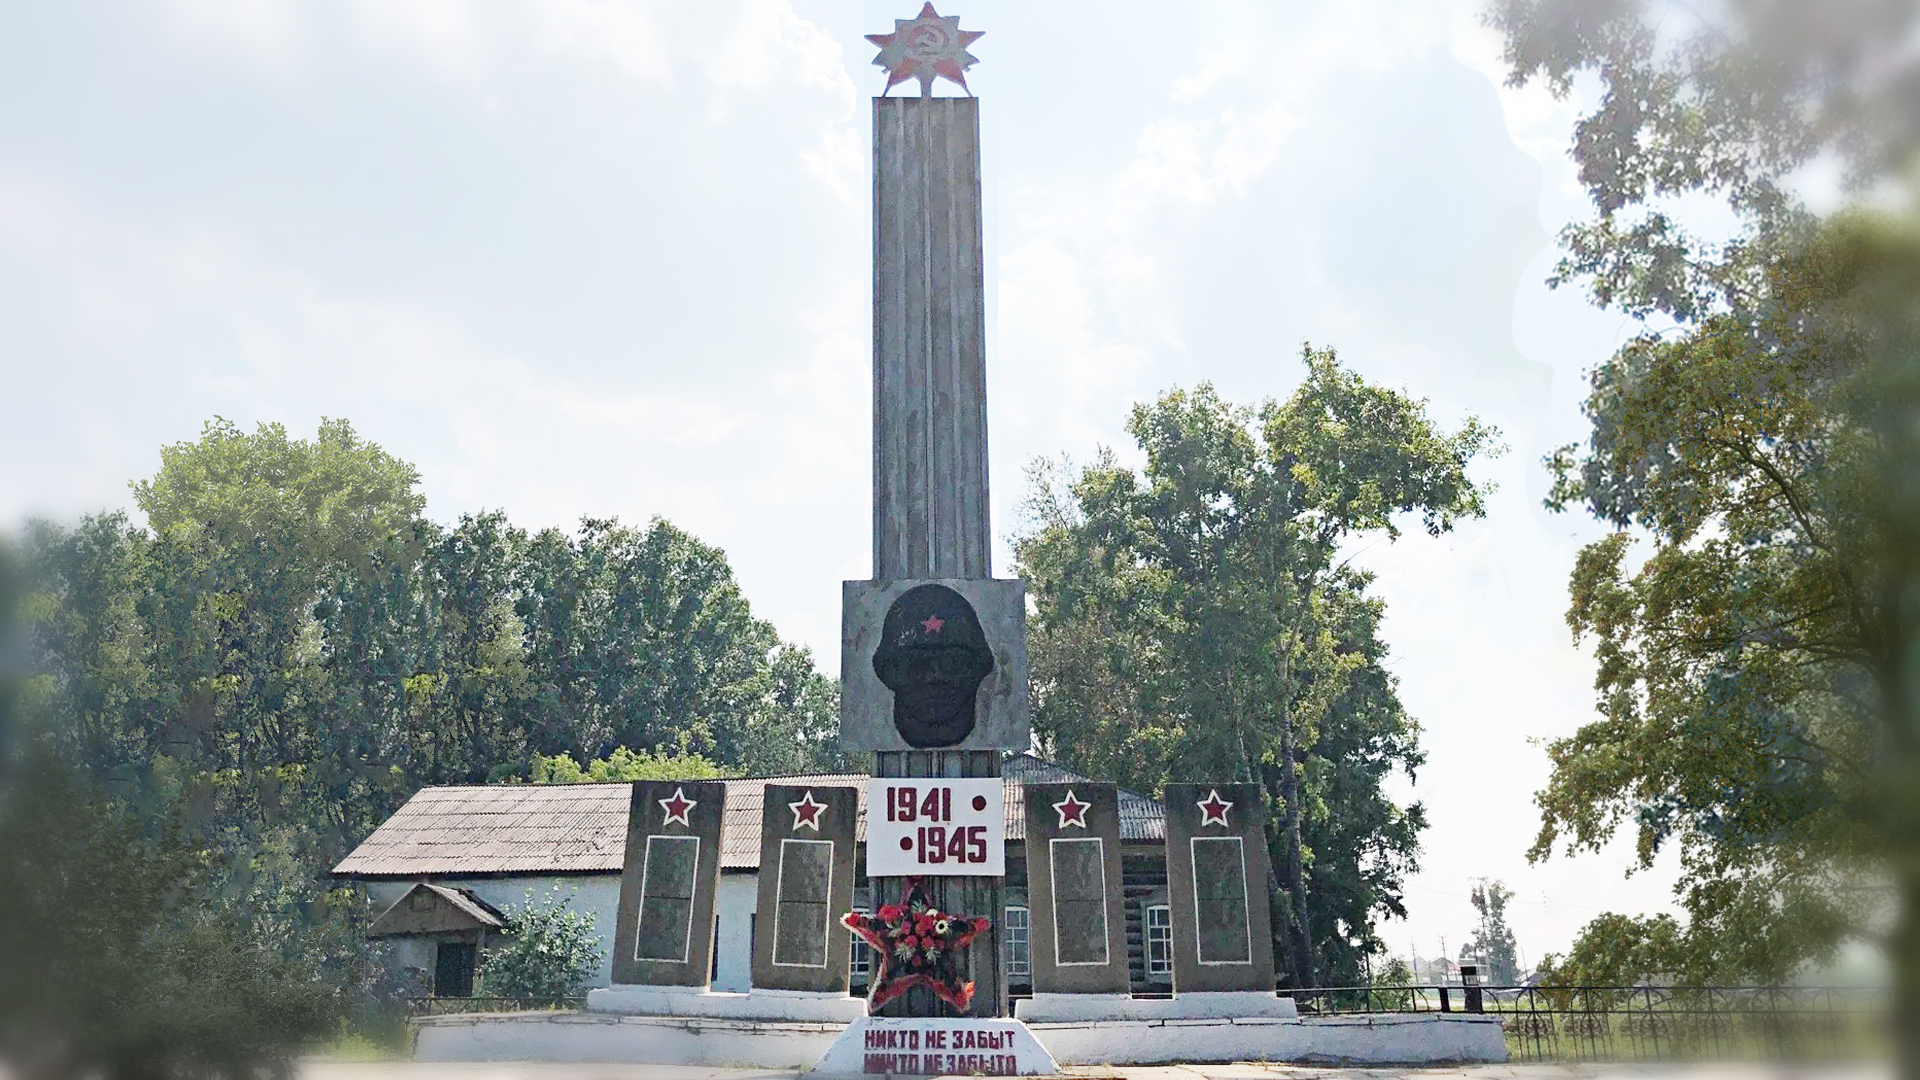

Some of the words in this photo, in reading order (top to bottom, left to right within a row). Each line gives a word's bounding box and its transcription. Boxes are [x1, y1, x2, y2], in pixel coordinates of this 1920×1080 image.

[887, 787, 951, 822] 1941
[917, 826, 987, 863] 1945
[865, 1030, 919, 1049] НИКТО
[926, 1030, 947, 1049] НЕ
[953, 1030, 1015, 1049] ЗАБЫТ
[924, 1054, 943, 1074] НЕ
